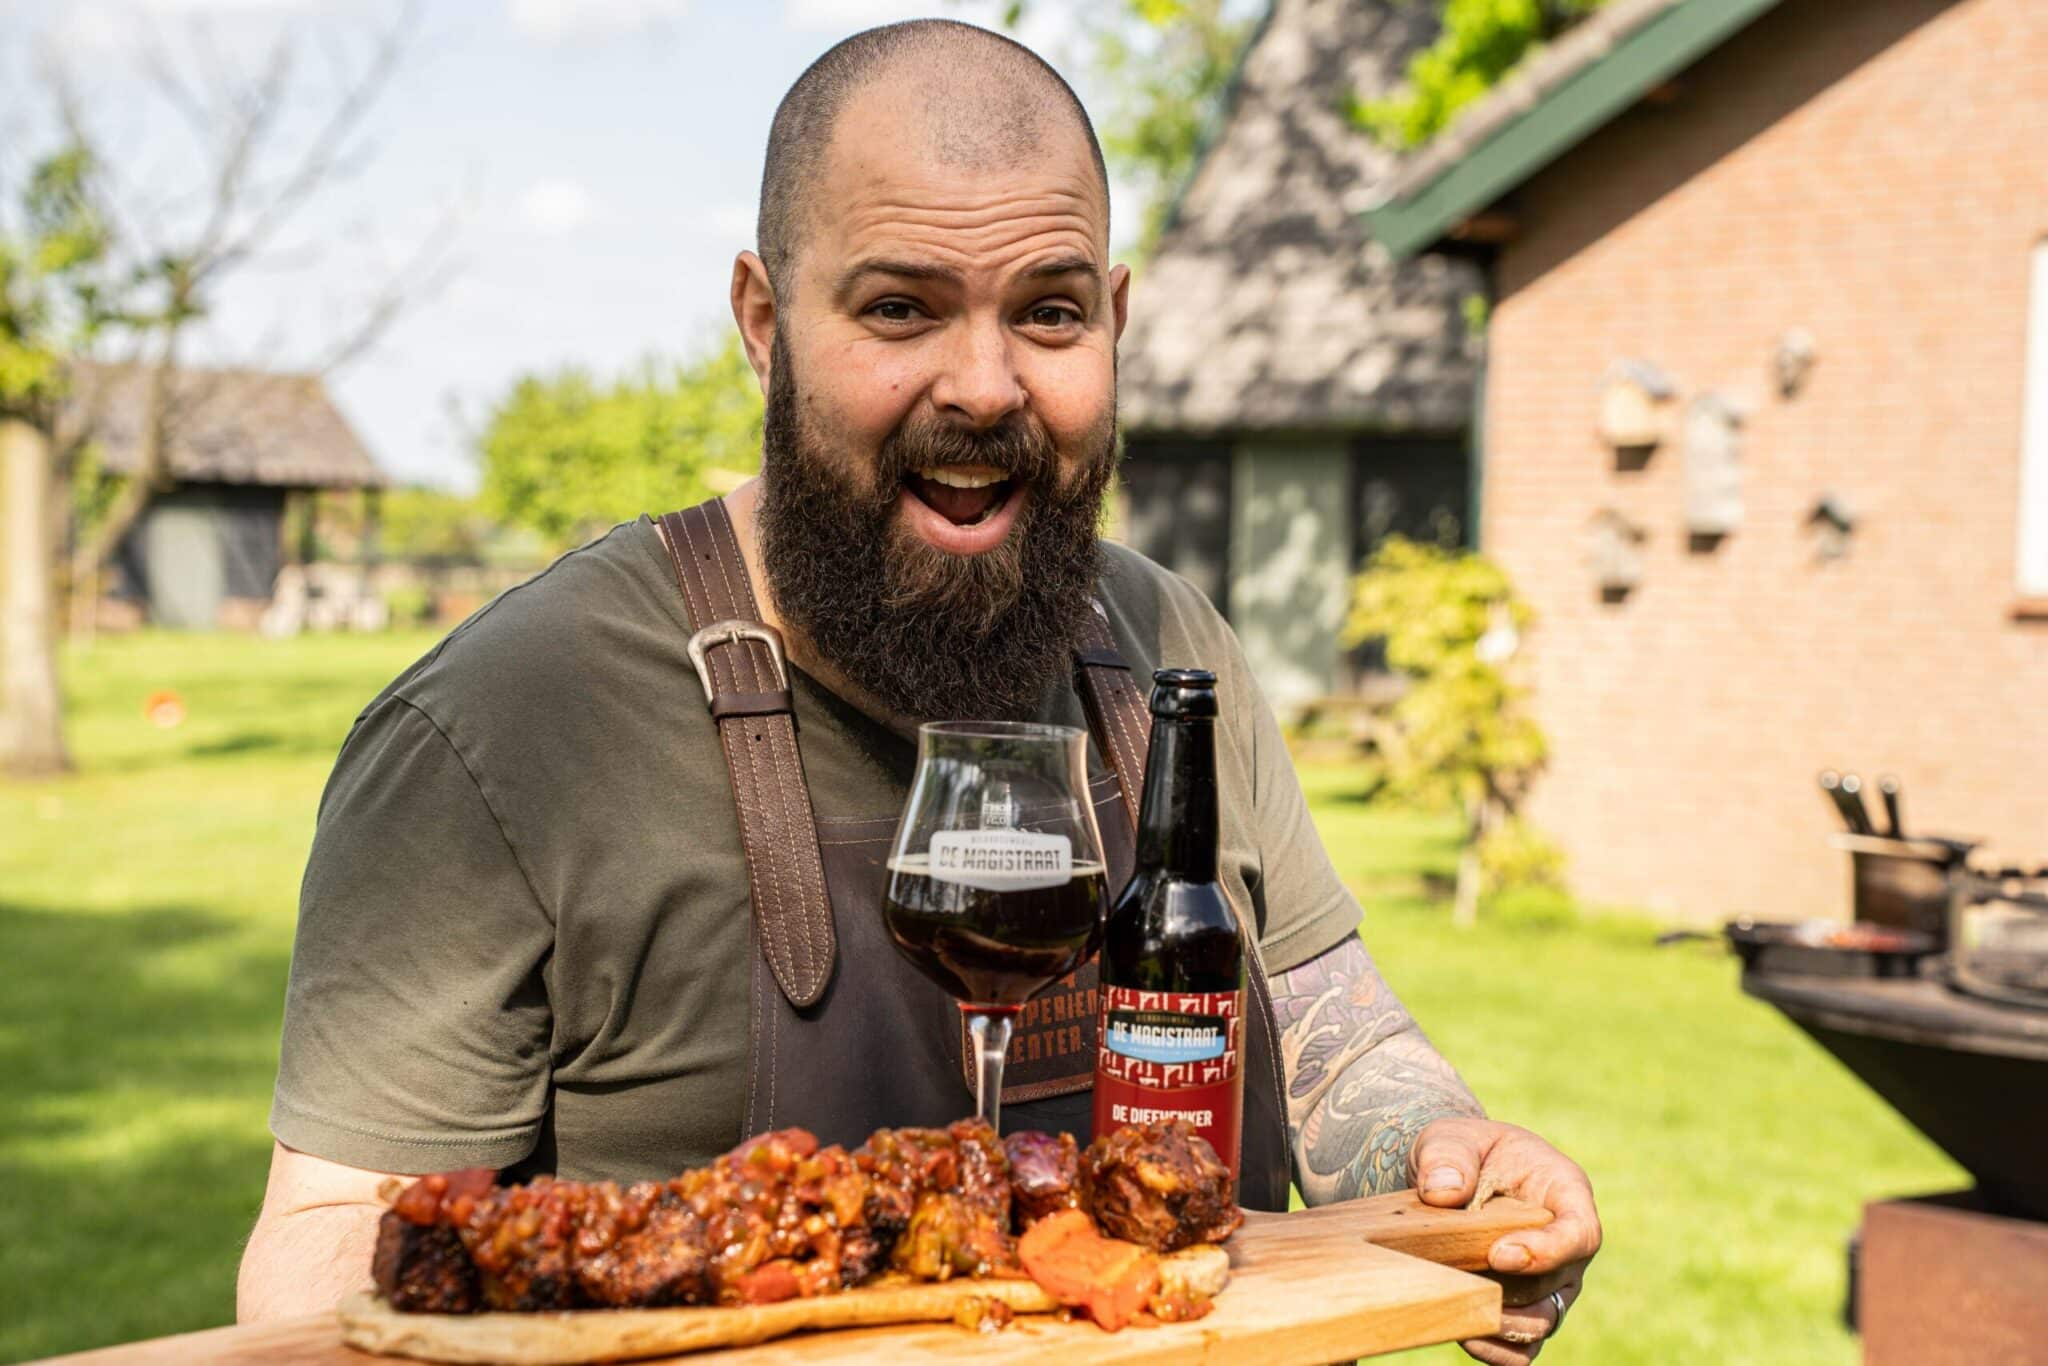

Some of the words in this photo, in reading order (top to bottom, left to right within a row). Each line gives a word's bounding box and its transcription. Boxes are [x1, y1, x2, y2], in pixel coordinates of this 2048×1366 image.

[939, 846, 959, 868] DE
[963, 847, 1061, 871] MAGISTRAAT
[1004, 1025, 1081, 1065] ENTER
[1112, 1021, 1128, 1044] DE
[1130, 1023, 1219, 1049] MAGISTRAAT
[1112, 1104, 1128, 1122] DE
